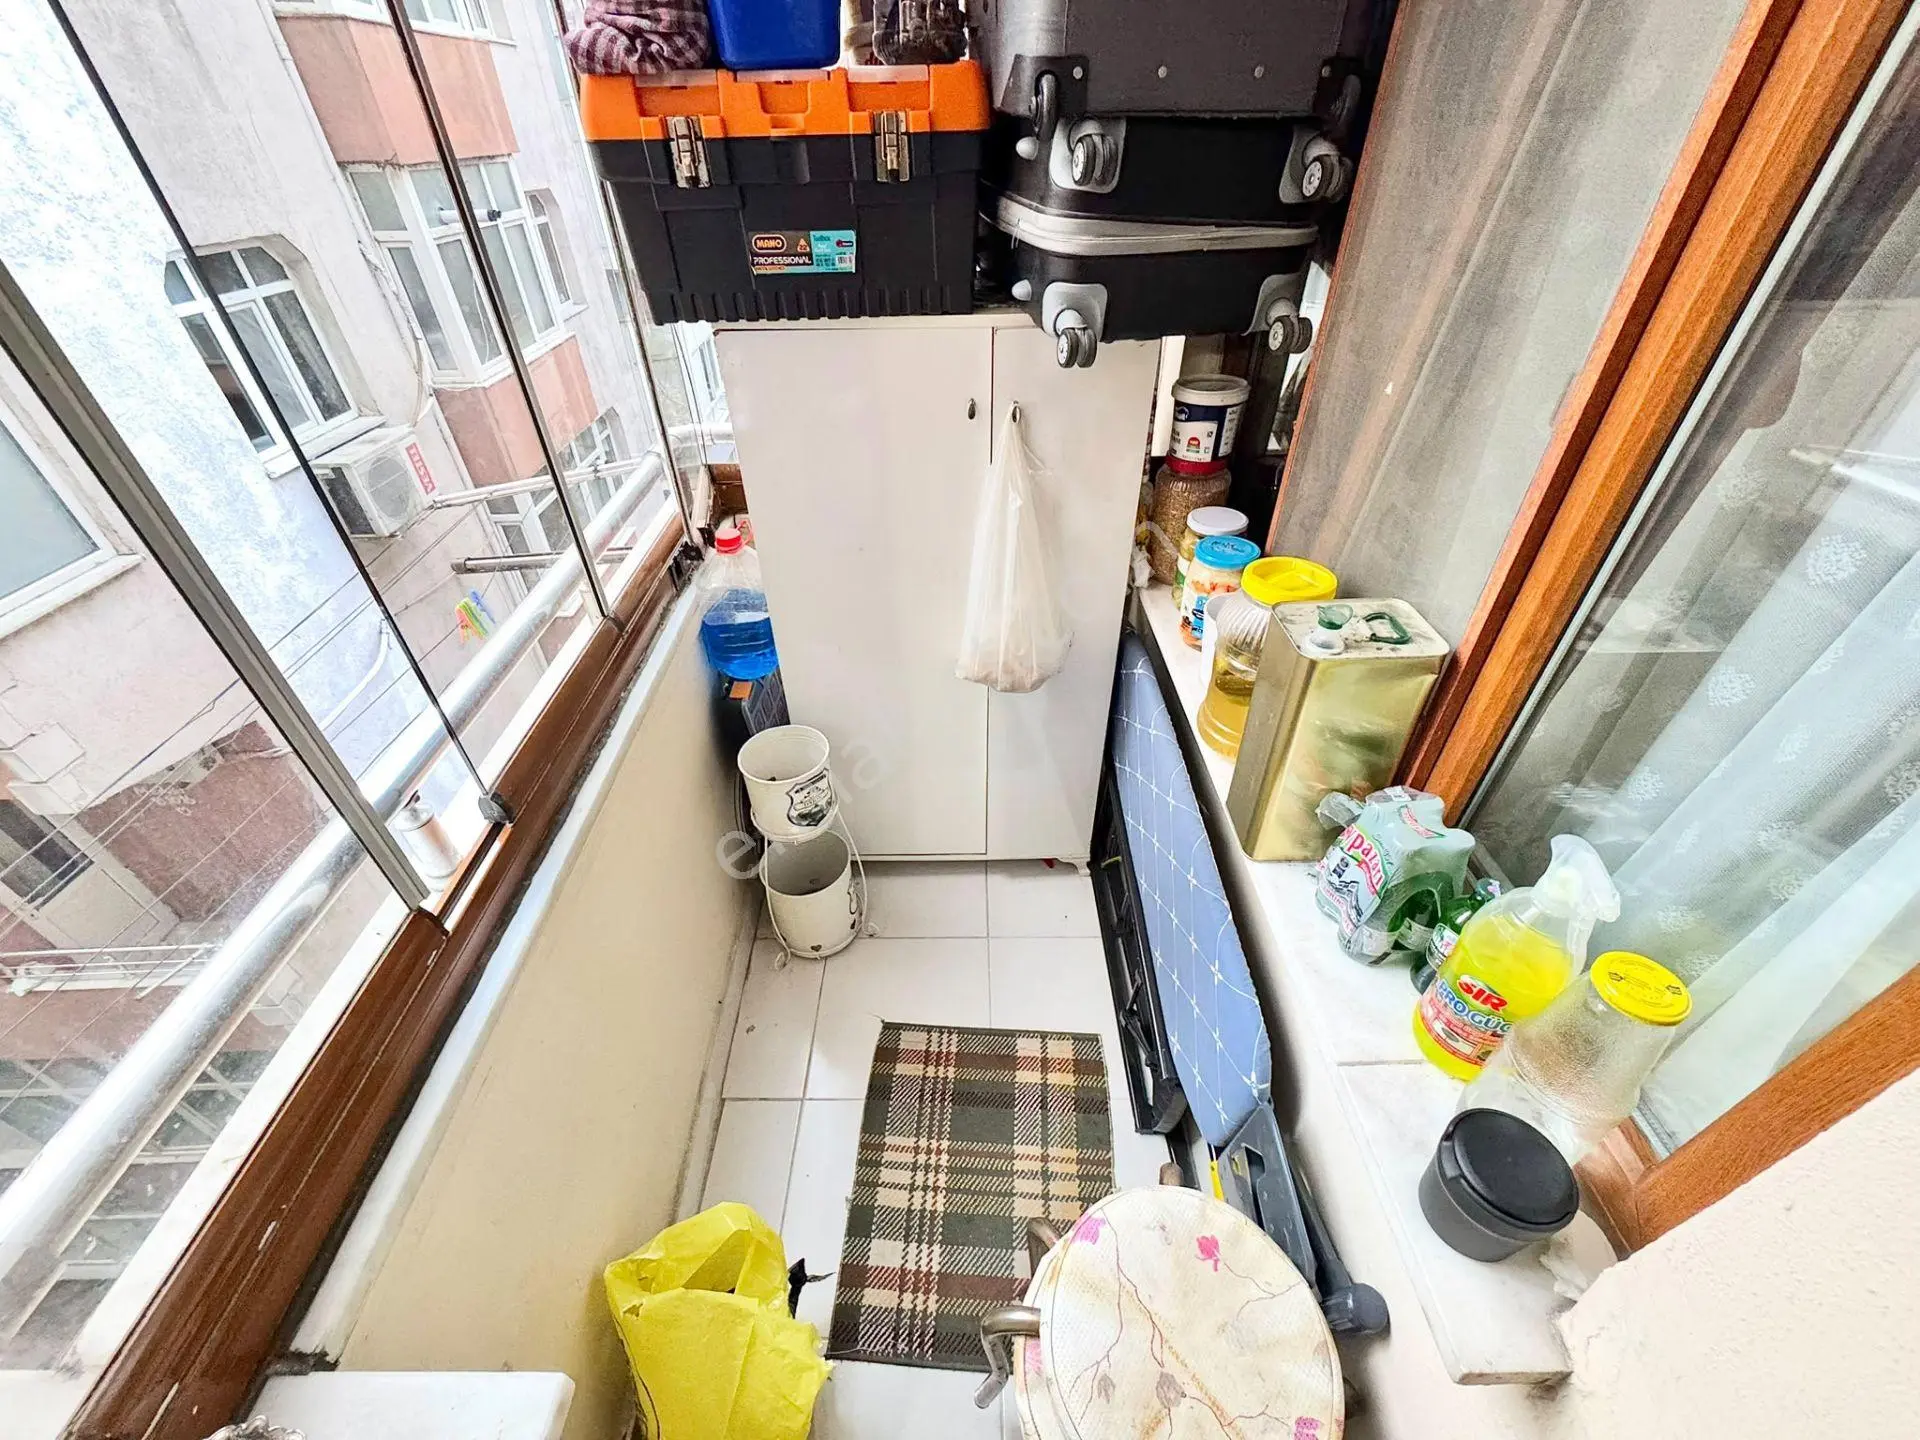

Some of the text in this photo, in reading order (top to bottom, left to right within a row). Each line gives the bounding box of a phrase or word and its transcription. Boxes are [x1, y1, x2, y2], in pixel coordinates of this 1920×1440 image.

[755, 239, 783, 249] MANO
[753, 256, 812, 265] PROFESSIONAL
[1458, 978, 1508, 1012] SIR
